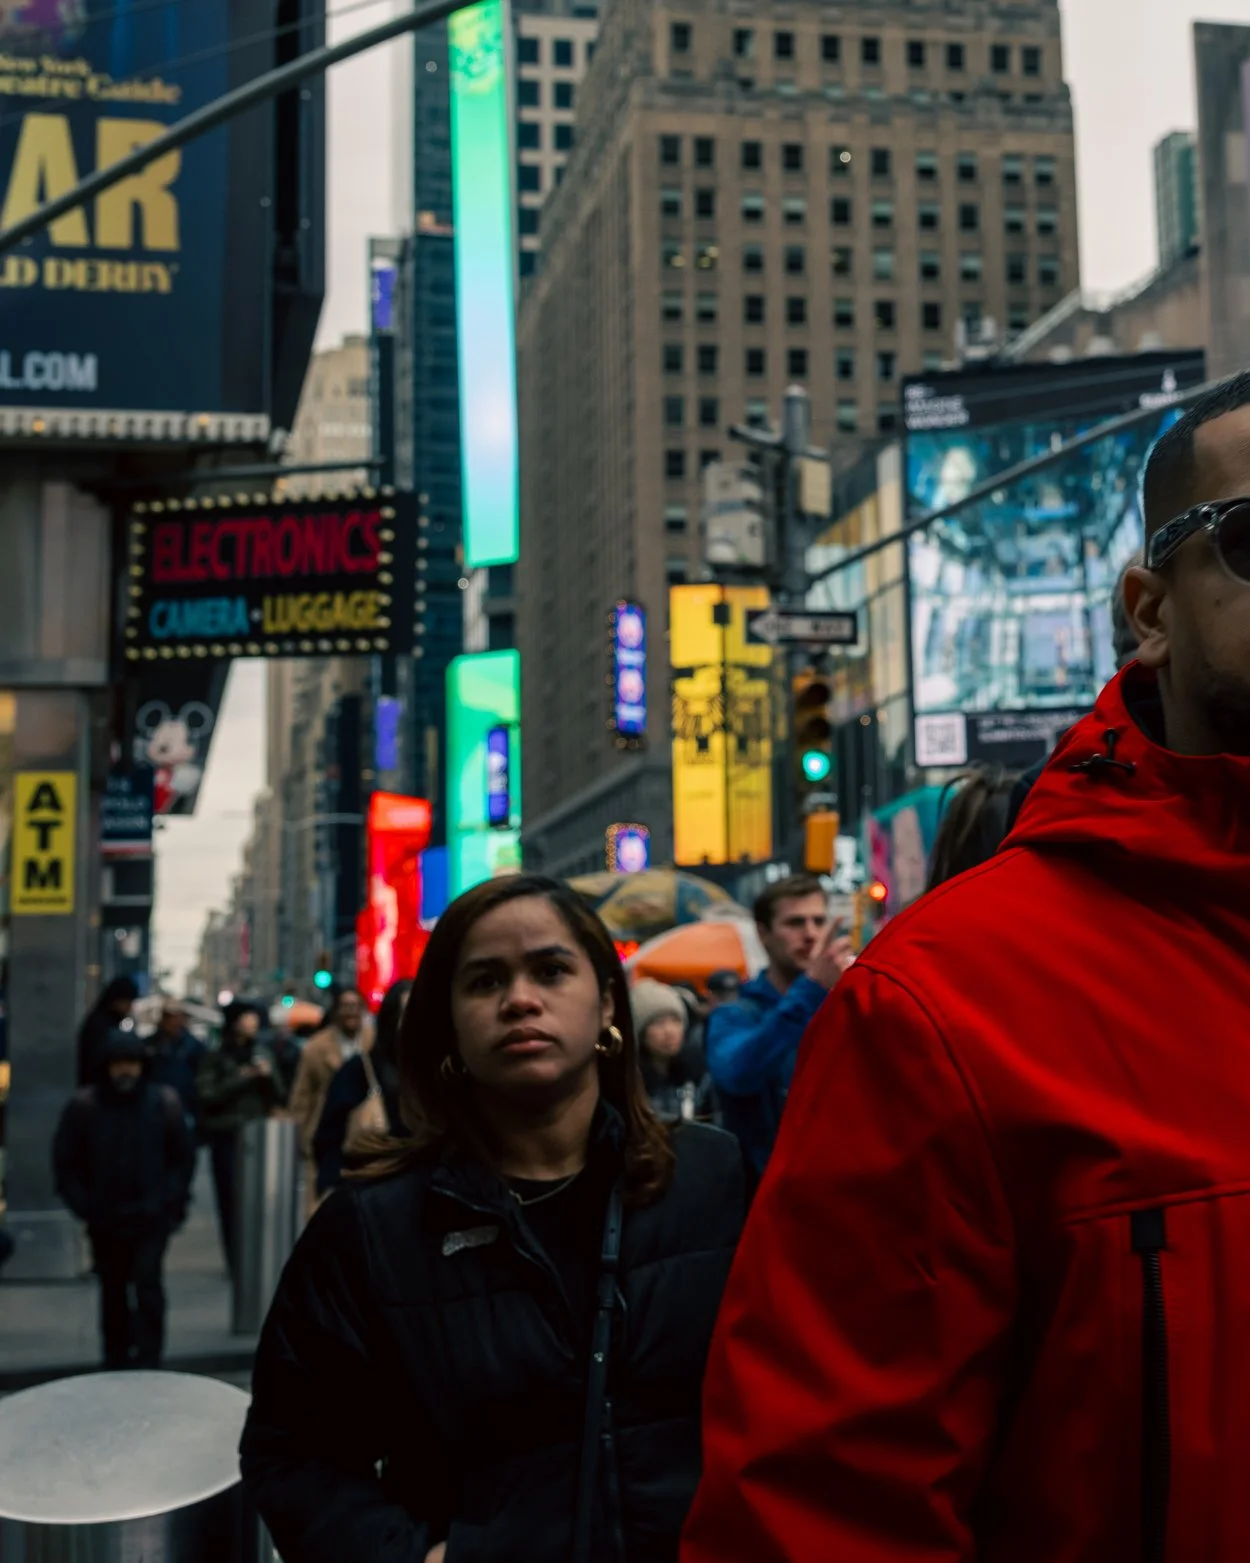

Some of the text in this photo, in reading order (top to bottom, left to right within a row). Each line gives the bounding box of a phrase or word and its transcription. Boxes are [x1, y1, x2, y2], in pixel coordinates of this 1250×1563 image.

[153, 511, 384, 583] ELECTRONICS
[149, 589, 383, 640] CAMERA LUGGAGE
[25, 780, 64, 891] ATM
